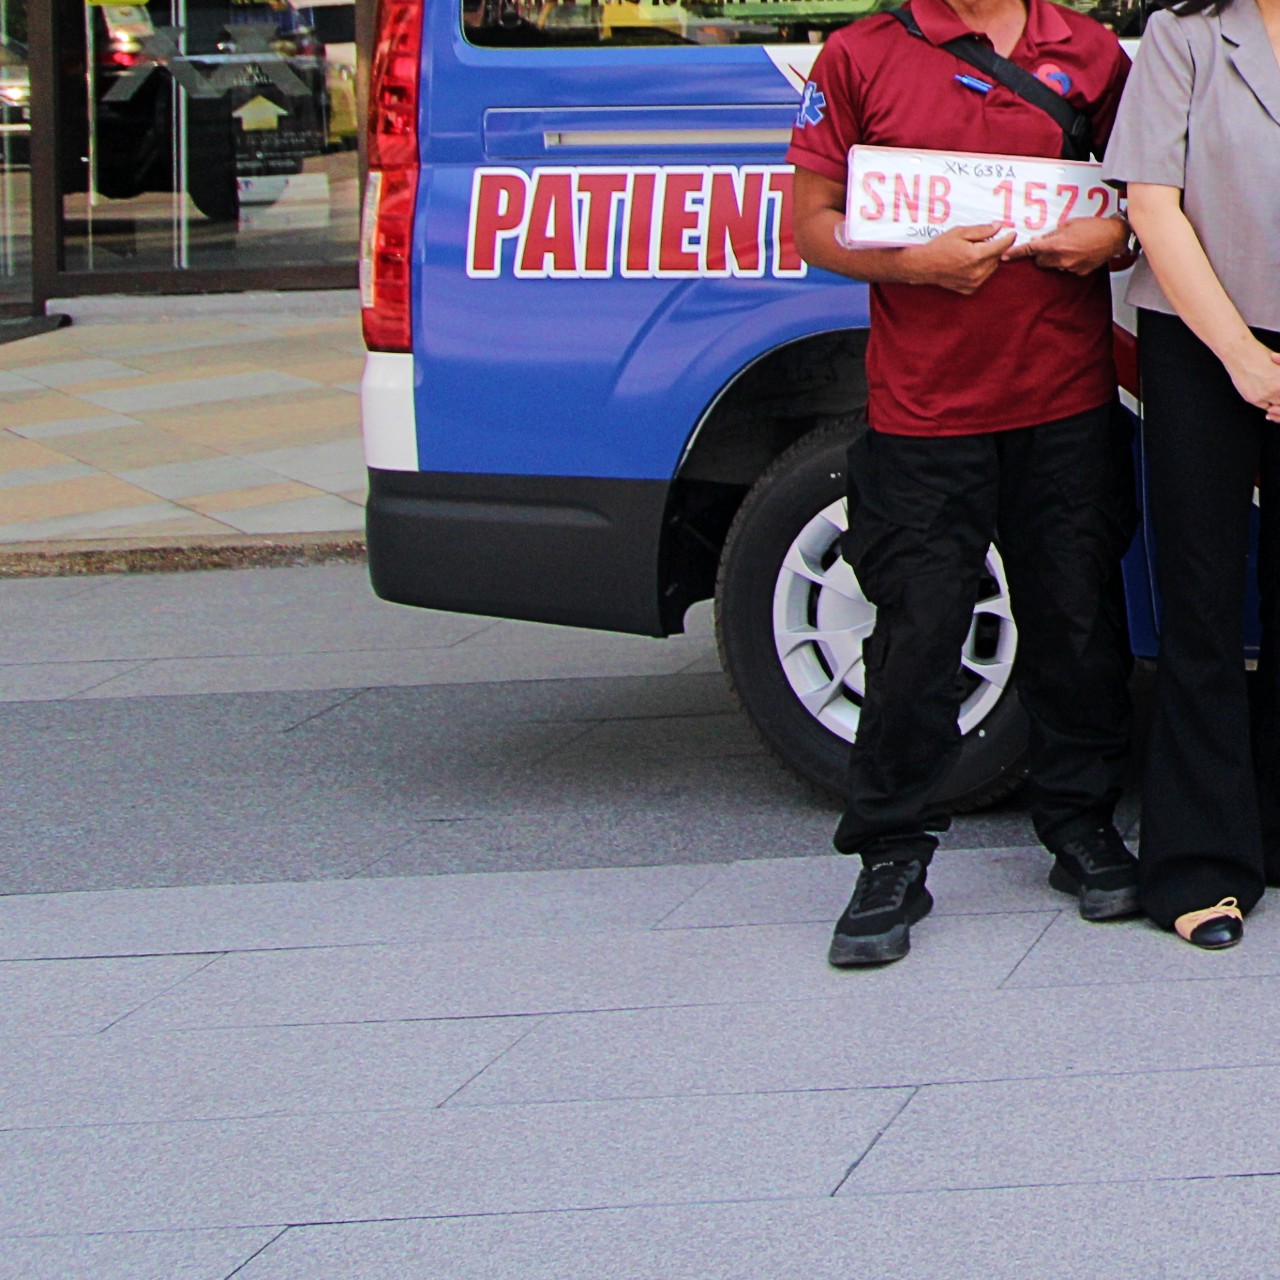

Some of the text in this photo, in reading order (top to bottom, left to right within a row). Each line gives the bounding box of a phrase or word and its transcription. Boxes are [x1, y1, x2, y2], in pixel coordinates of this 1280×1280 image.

[467, 166, 807, 278] PATIENT
[860, 171, 1110, 231] SNB 1572
